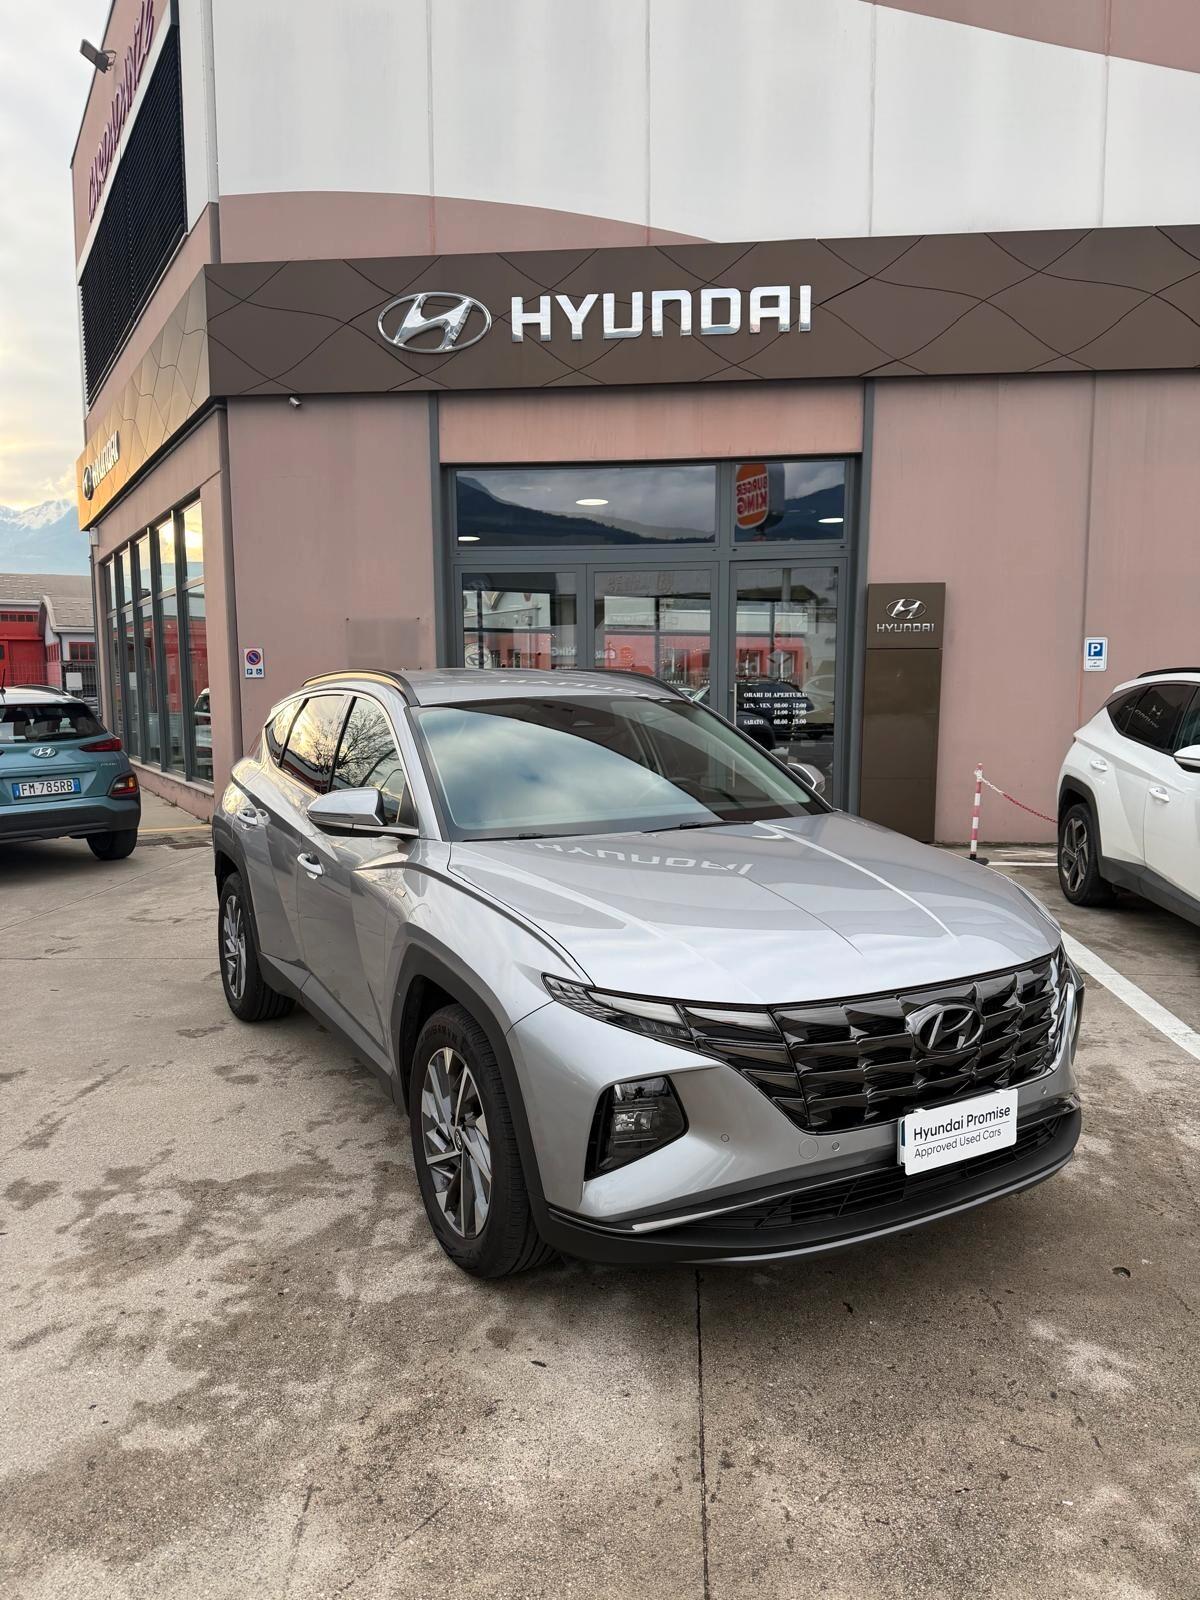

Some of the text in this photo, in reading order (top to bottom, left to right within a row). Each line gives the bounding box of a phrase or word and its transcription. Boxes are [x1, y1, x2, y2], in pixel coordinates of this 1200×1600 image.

[511, 285, 812, 343] HYUNDAI
[876, 623, 934, 633] HYUNDAI
[913, 1106, 1011, 1141] Hyundai Promise
[914, 1128, 1002, 1159] Approved Used Cars
